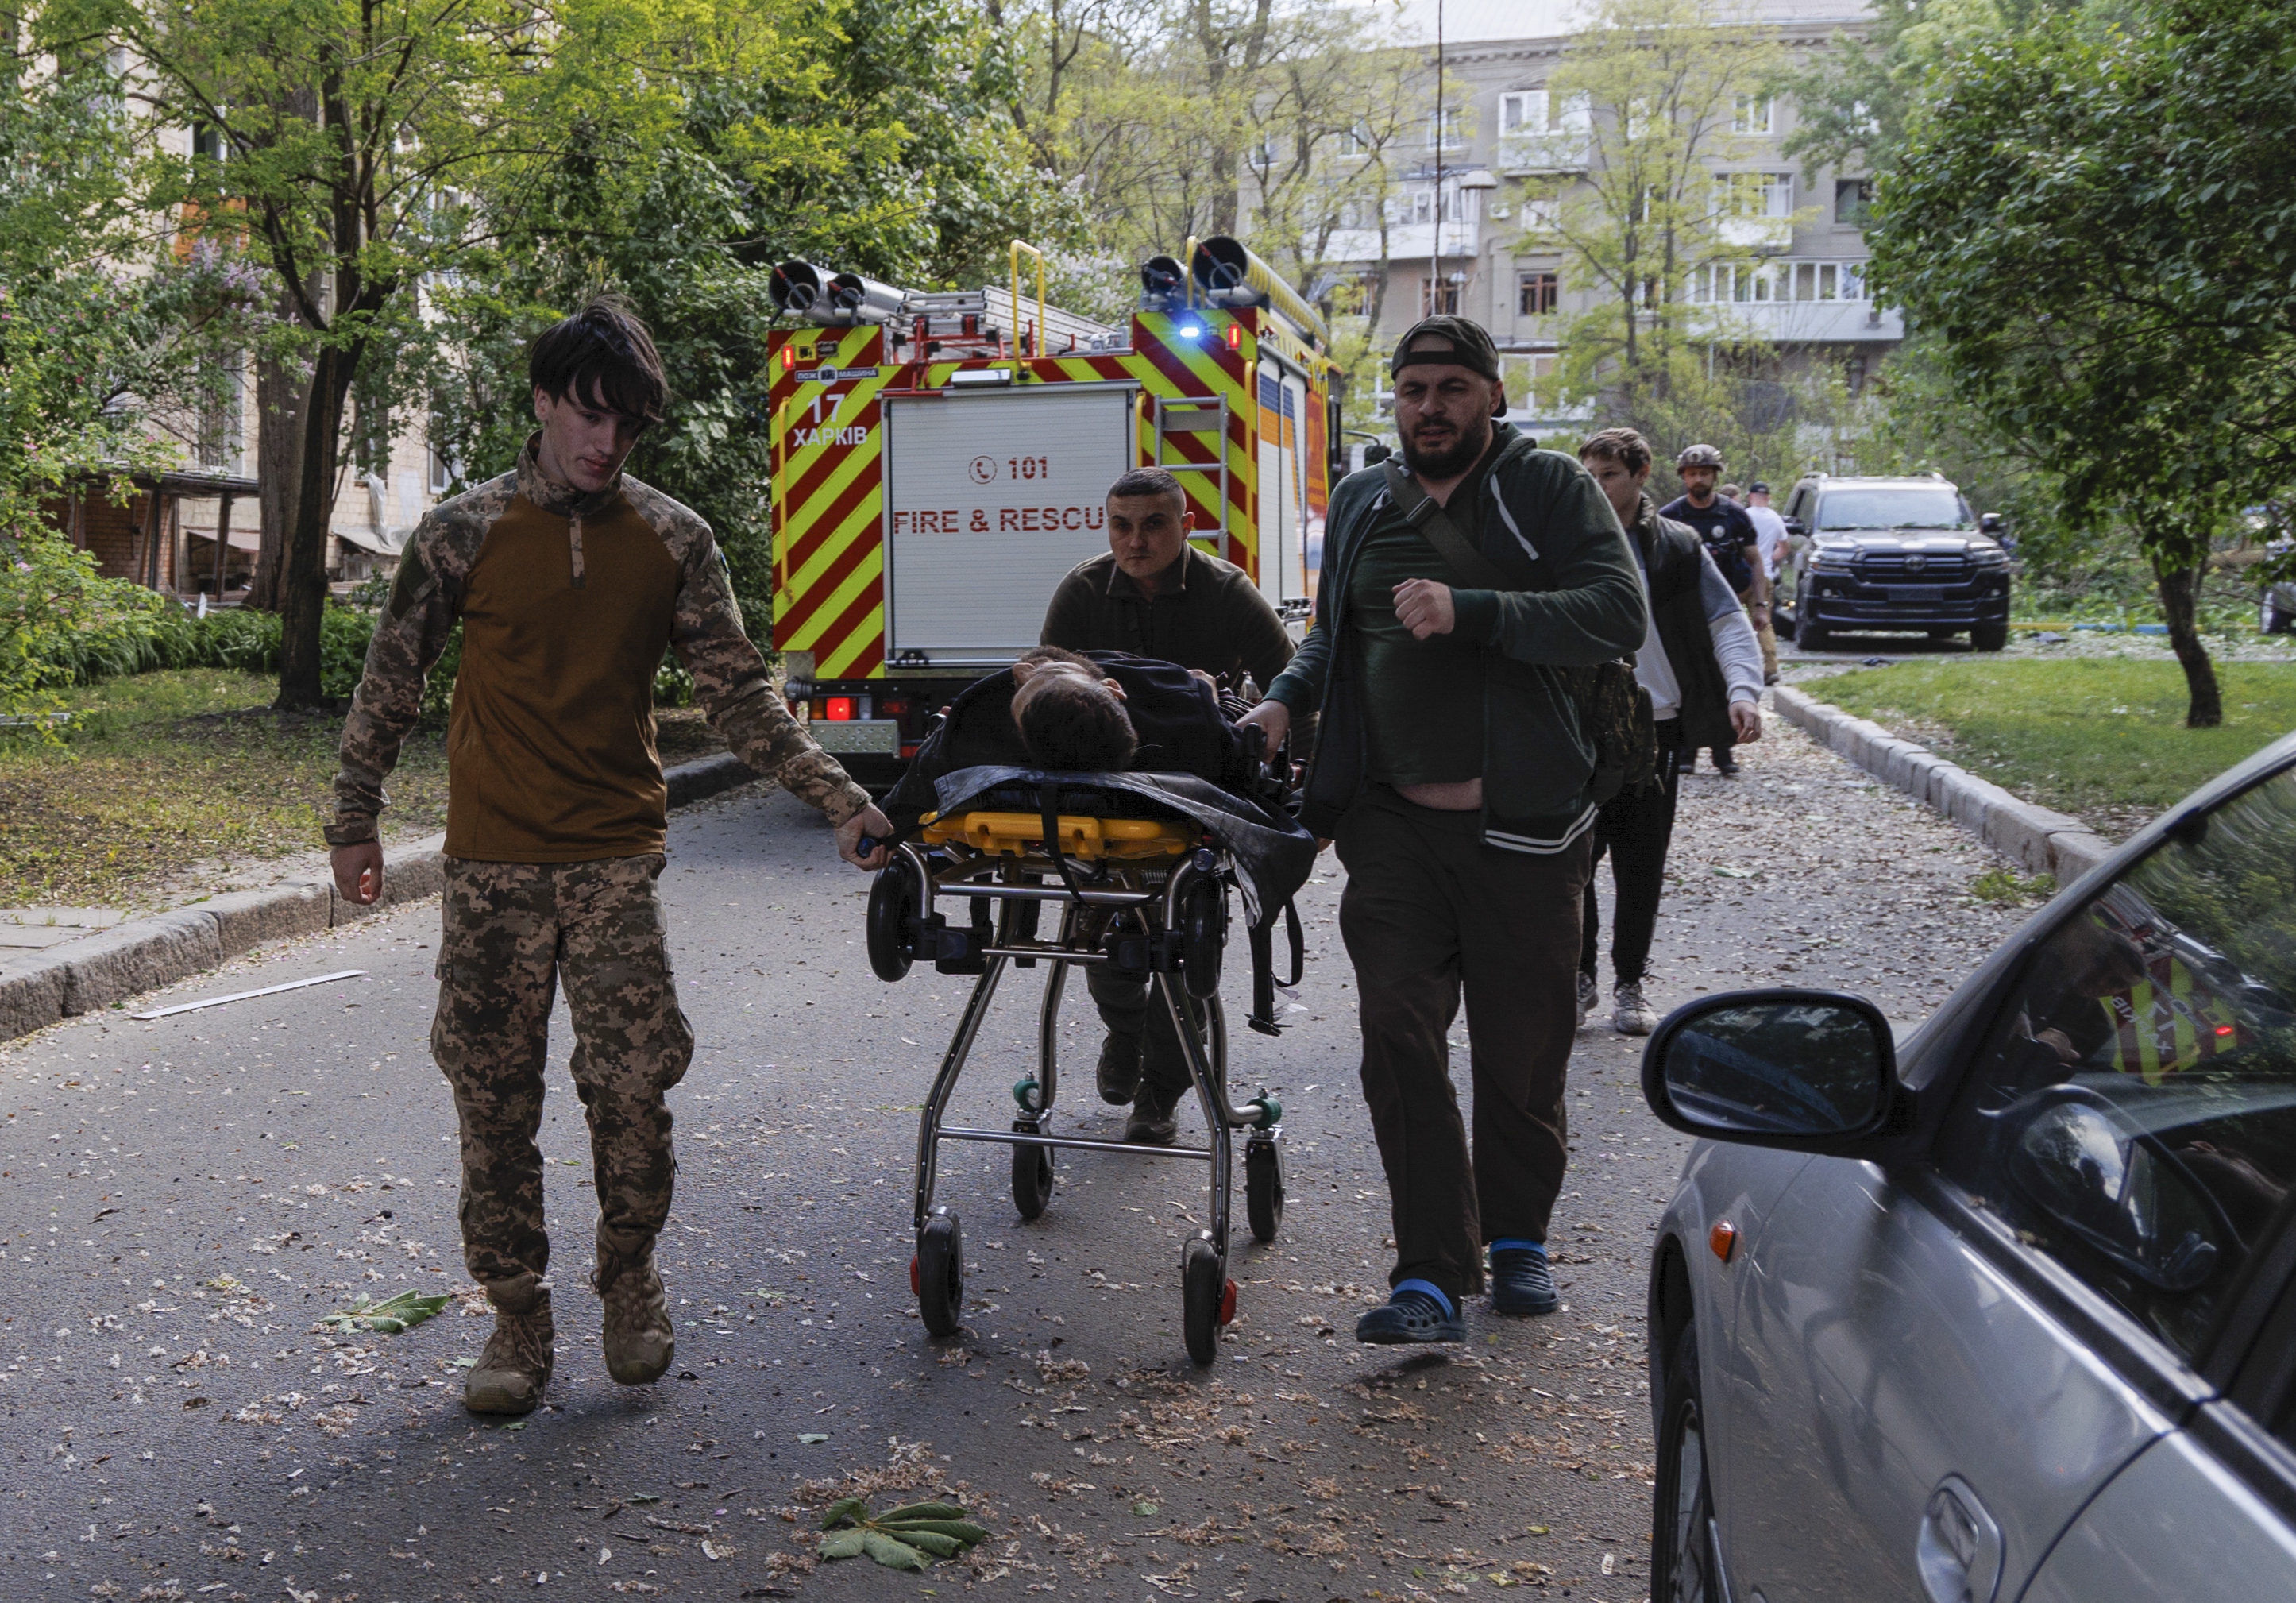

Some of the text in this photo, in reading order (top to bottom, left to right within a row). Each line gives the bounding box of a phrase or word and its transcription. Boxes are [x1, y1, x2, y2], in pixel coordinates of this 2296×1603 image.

[808, 394, 845, 423] 17
[793, 427, 867, 446] ХАРКІВ
[1008, 456, 1048, 480] 101
[893, 506, 1104, 534] FIRE & RESCU
